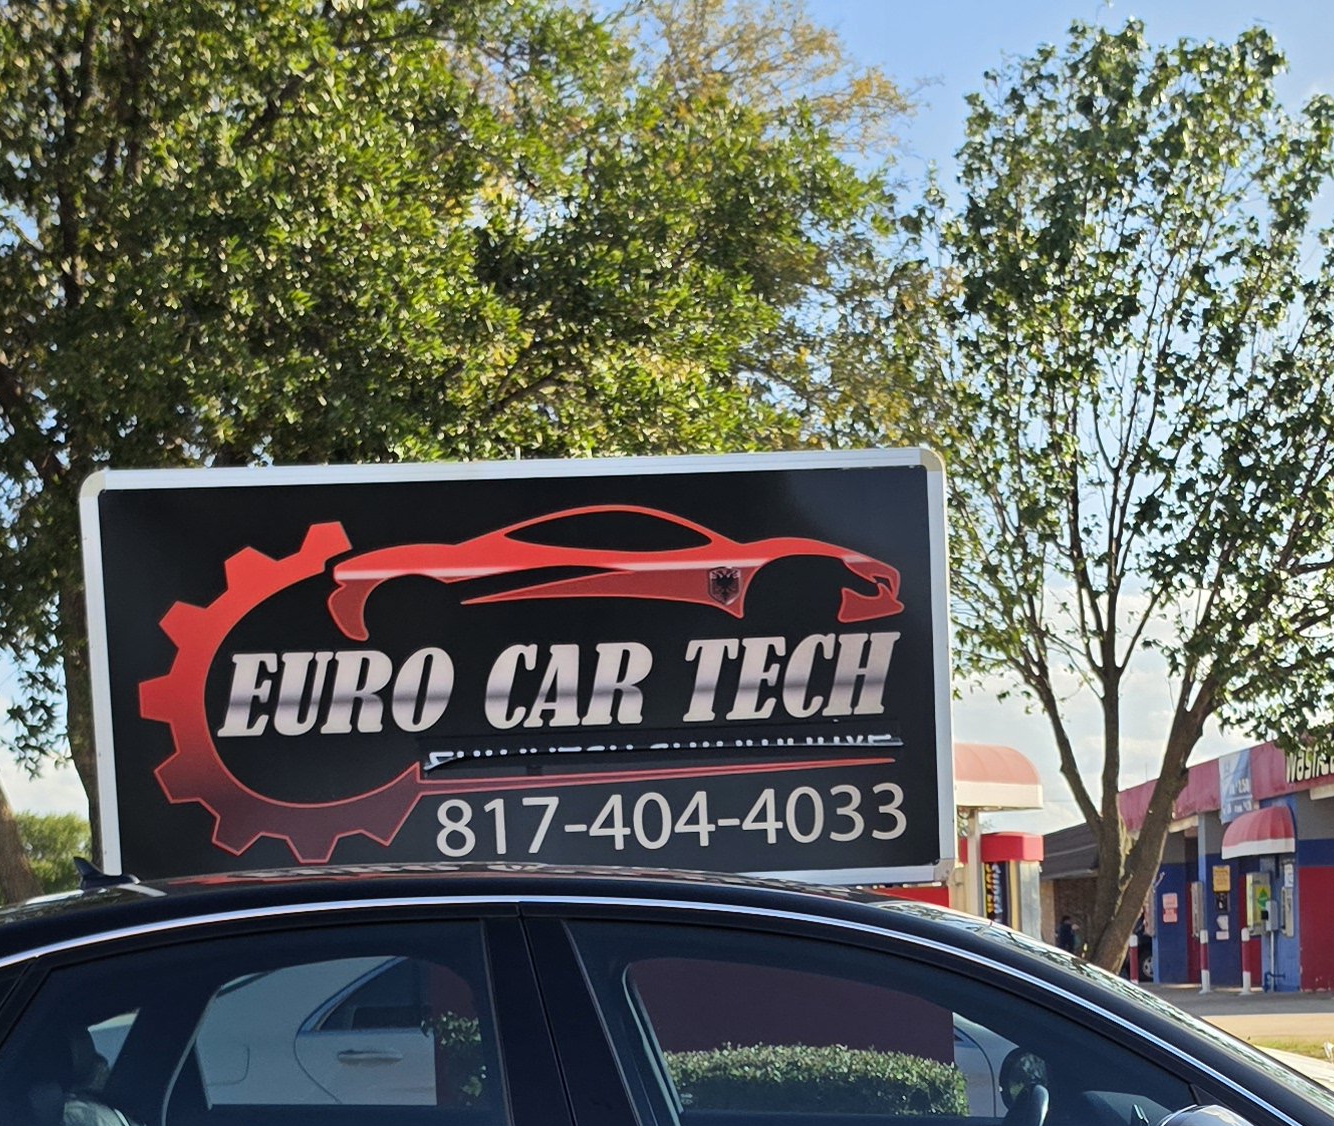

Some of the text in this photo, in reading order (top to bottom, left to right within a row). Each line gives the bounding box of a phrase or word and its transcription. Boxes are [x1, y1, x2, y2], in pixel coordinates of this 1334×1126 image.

[218, 631, 901, 737] EURO CAR TECH
[436, 782, 907, 857] 817-404-4033
